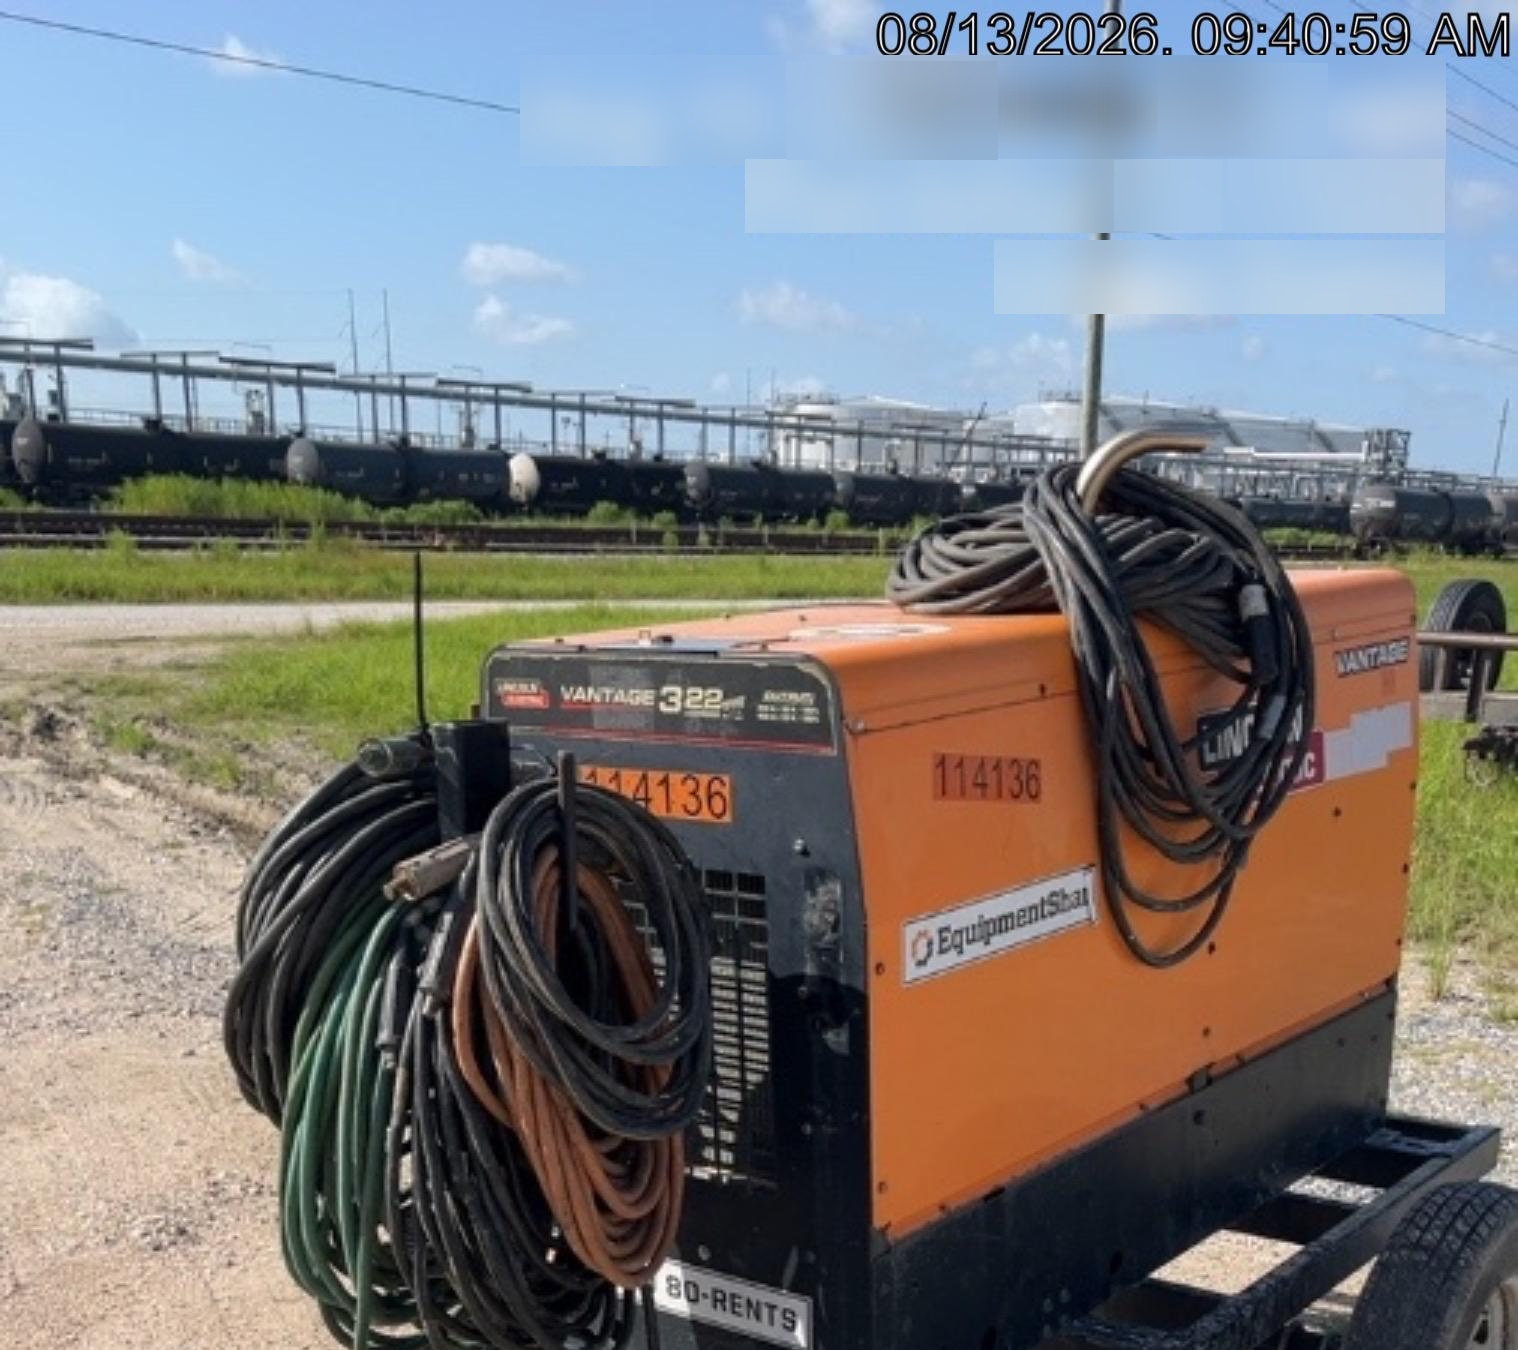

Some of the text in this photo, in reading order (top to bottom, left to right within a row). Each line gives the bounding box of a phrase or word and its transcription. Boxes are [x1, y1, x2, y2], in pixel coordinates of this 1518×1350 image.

[1336, 638, 1409, 675] VANTAGE
[561, 684, 656, 706] VANTAGE
[659, 686, 723, 713] 322
[1203, 702, 1304, 763] LINCN
[936, 754, 1040, 799] 114136
